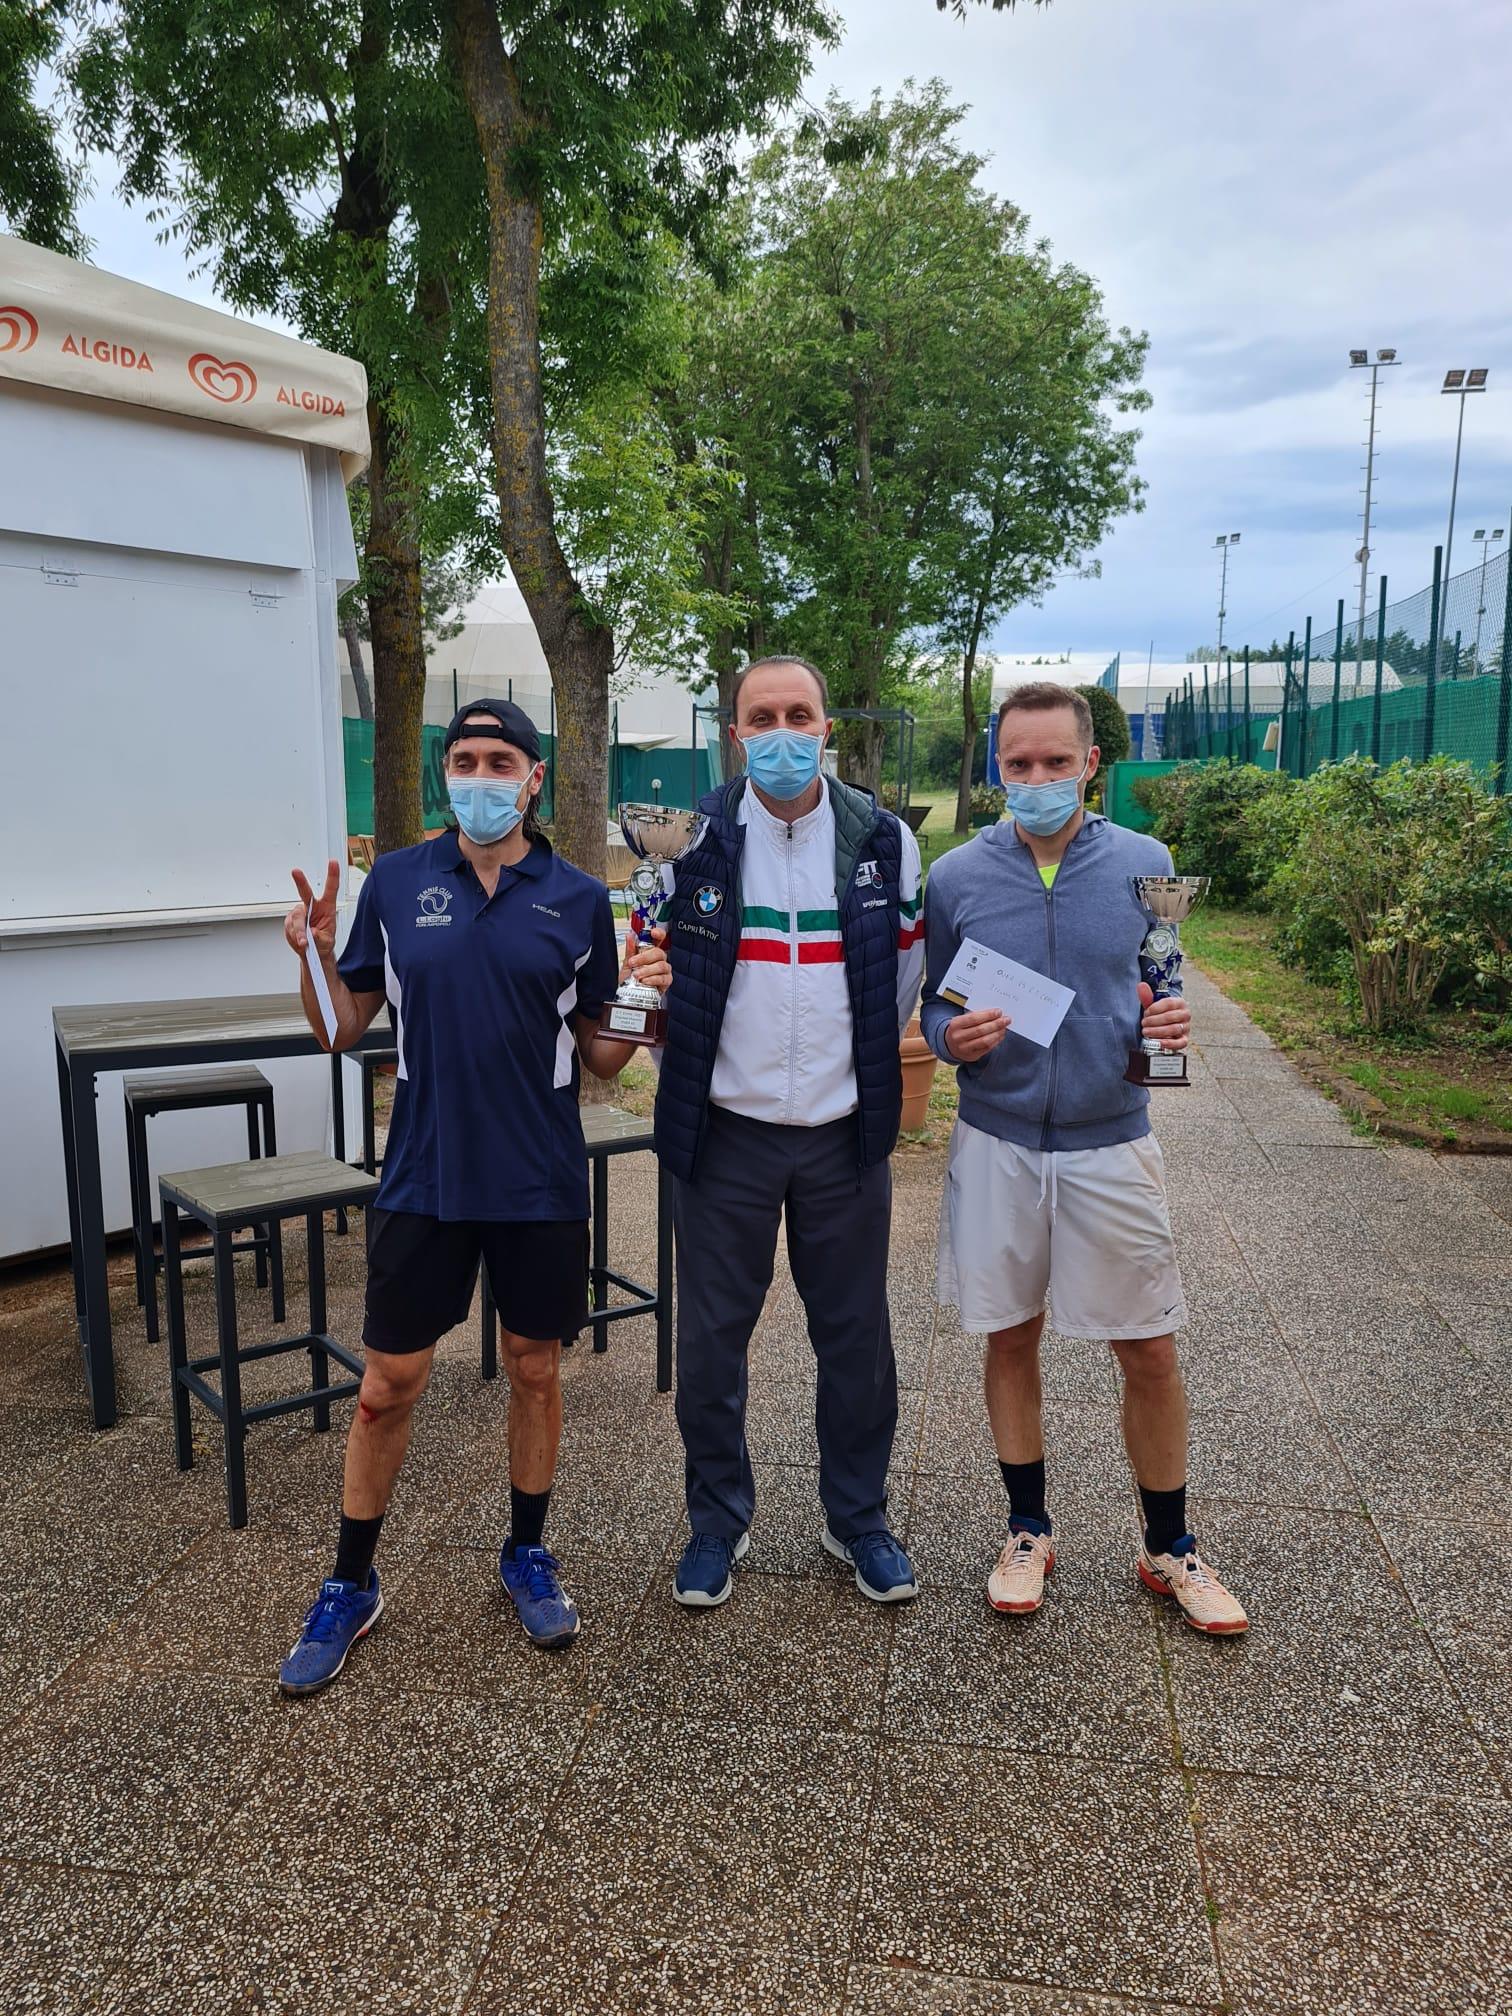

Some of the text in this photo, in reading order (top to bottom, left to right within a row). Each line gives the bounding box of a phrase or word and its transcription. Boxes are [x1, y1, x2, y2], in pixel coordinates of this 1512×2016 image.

[61, 334, 154, 372] ALGIDA
[276, 385, 346, 417] ALGIDA
[416, 886, 453, 901] TENNIS CLUB
[532, 903, 561, 918] HEAD
